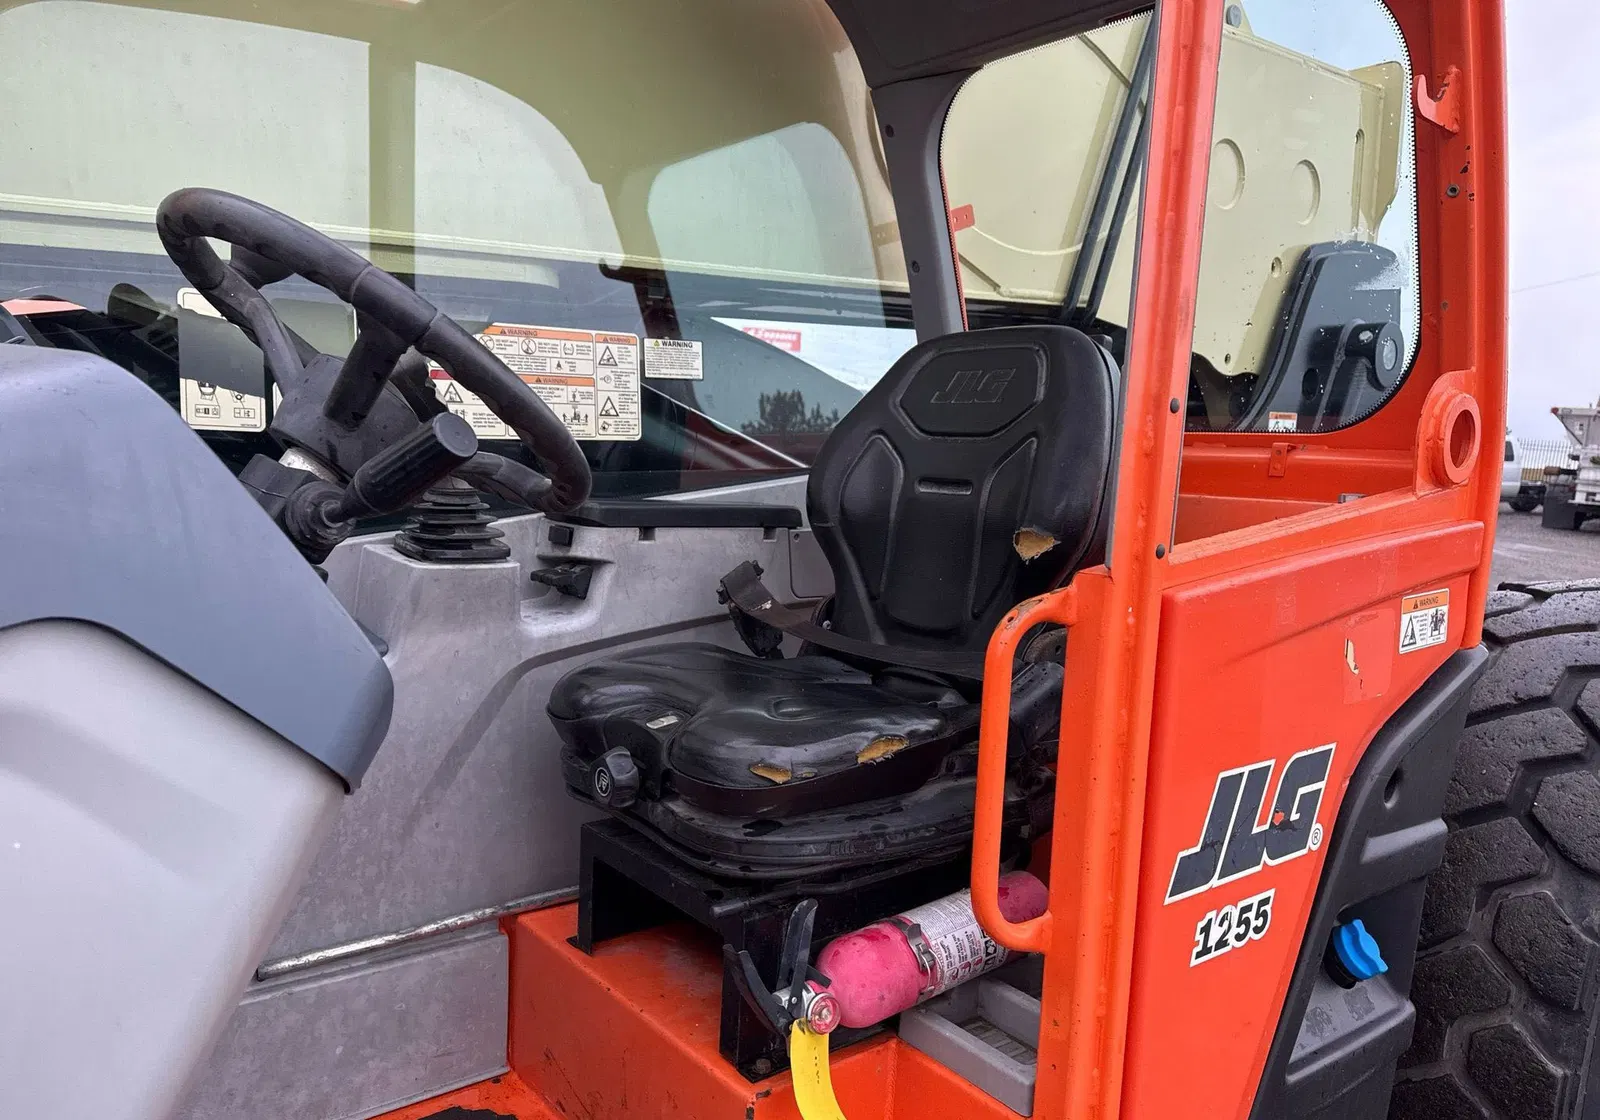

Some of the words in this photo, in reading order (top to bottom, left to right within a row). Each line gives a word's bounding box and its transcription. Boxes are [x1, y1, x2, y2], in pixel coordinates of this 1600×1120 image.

[507, 329, 538, 337] WARNING
[609, 336, 631, 344] WARNING
[661, 340, 693, 348] WARNING
[930, 368, 1016, 403] JLG
[1419, 596, 1439, 607] WARNING
[1164, 743, 1336, 904] JLG
[1192, 892, 1273, 963] 1255
